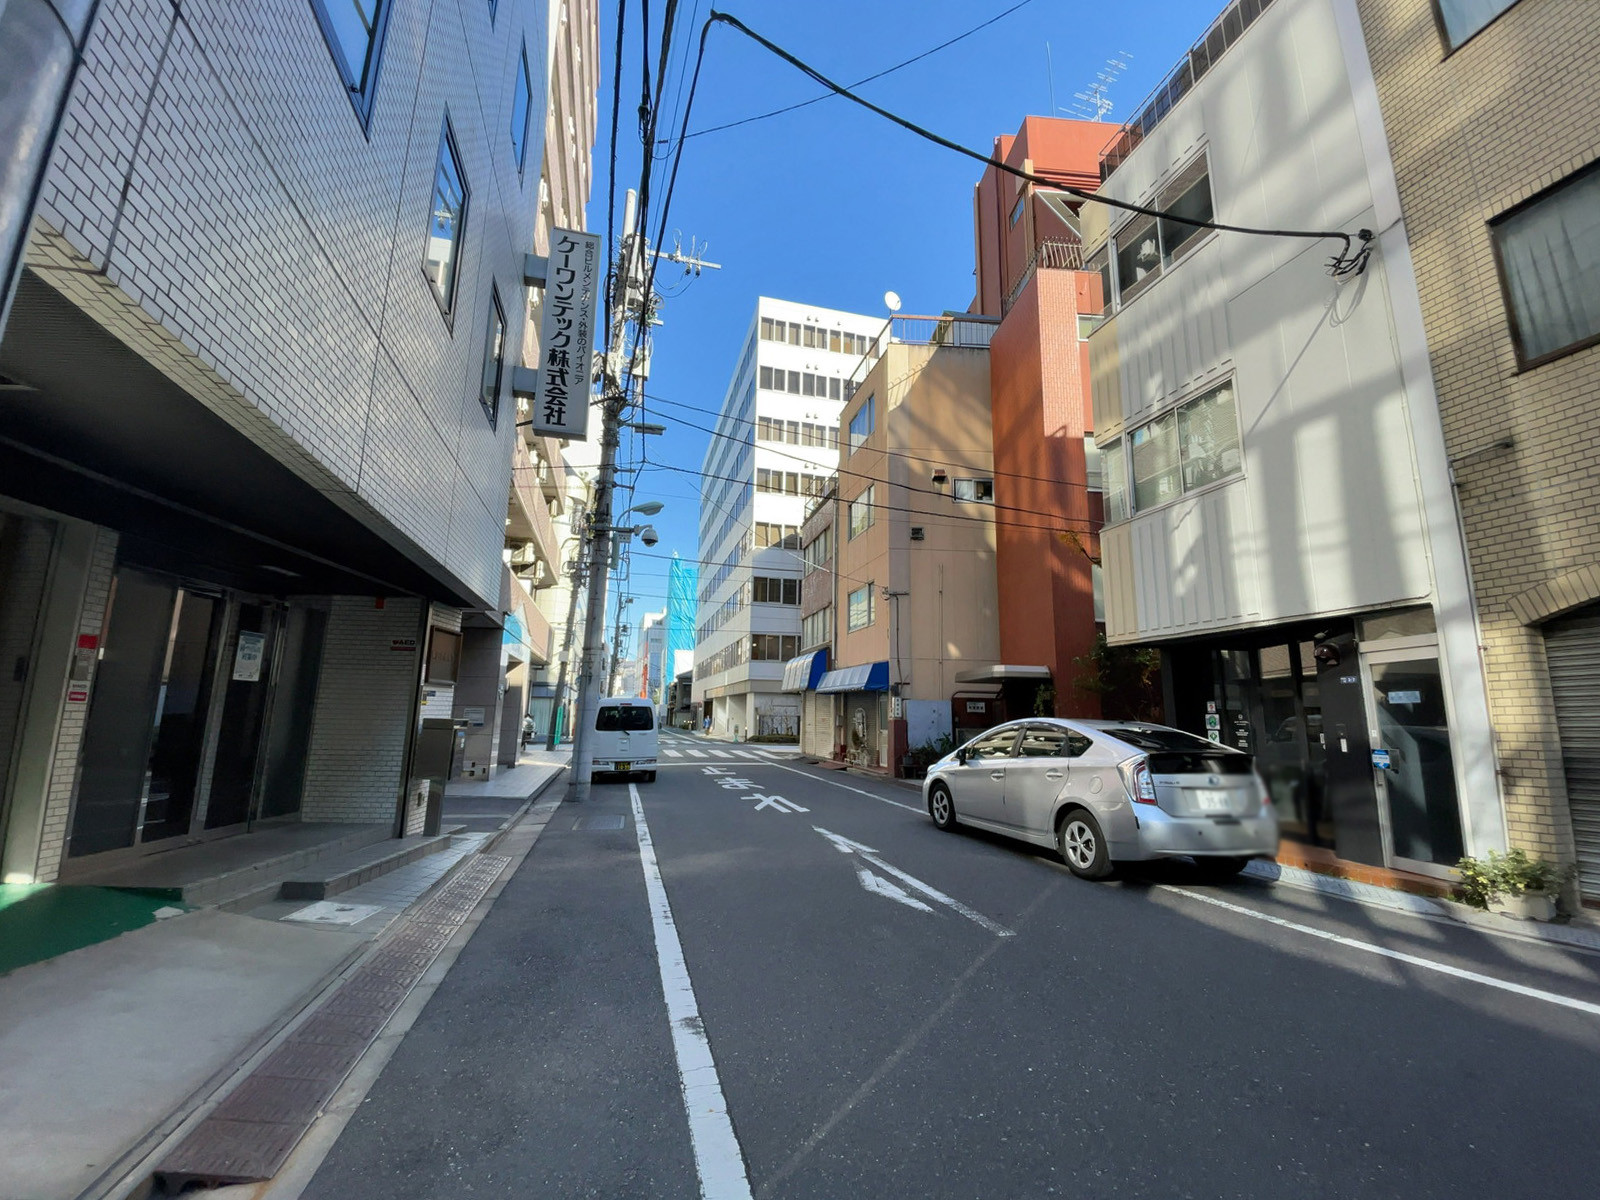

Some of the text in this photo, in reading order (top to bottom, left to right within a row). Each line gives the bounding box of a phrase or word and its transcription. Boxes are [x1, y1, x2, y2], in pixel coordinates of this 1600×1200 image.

[543, 235, 580, 427] ケーワンテック株式会社
[700, 766, 811, 813] 止まれ
